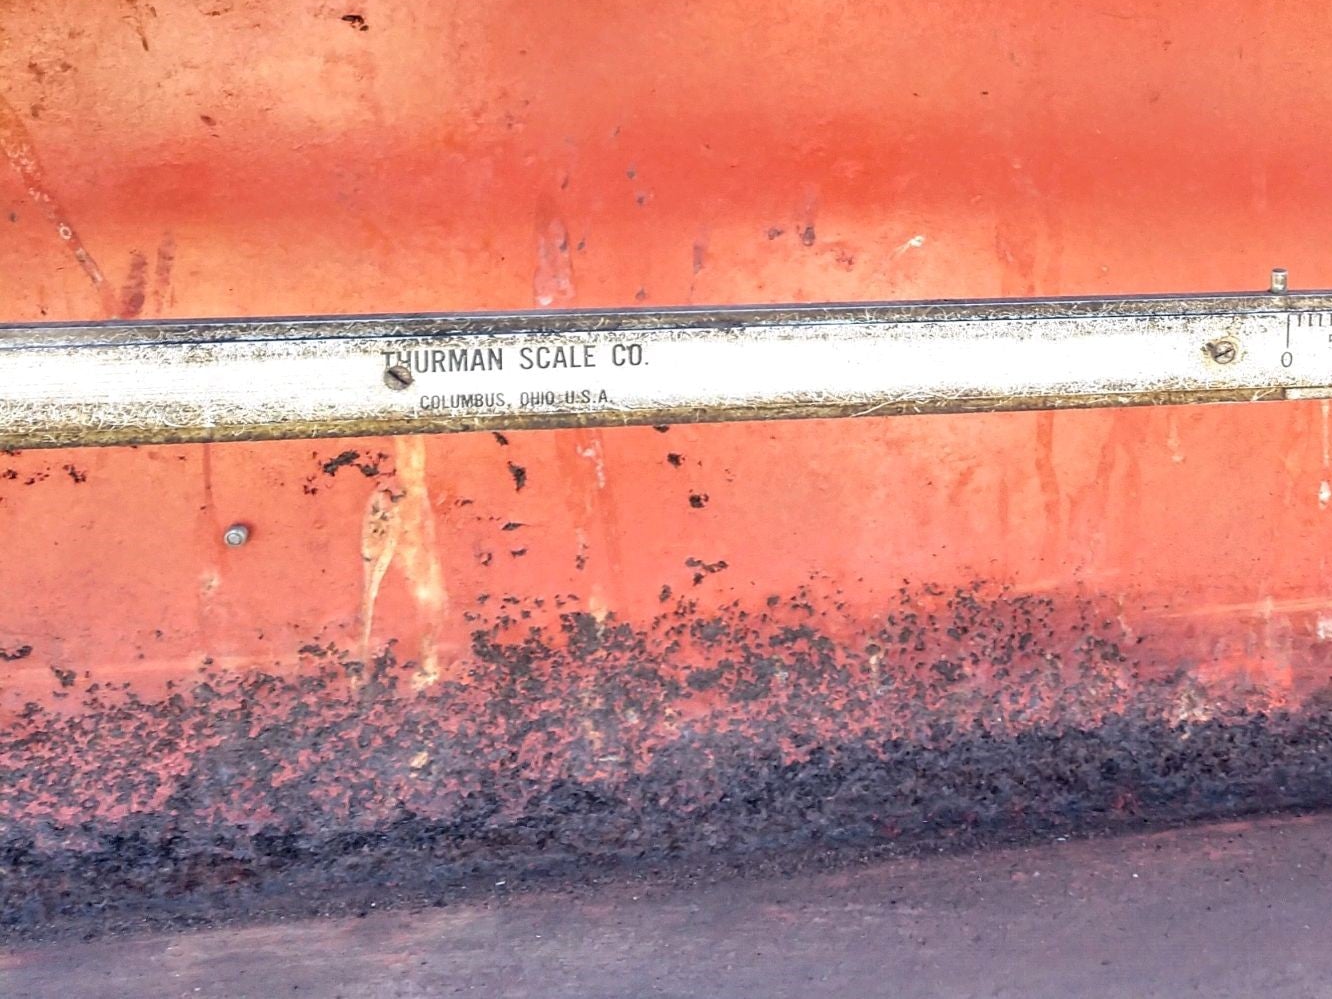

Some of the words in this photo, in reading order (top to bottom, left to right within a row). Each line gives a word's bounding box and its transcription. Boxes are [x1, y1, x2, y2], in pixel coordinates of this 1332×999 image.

[519, 345, 597, 370] SCALE
[611, 343, 650, 367] CO.
[1281, 351, 1293, 368] 0
